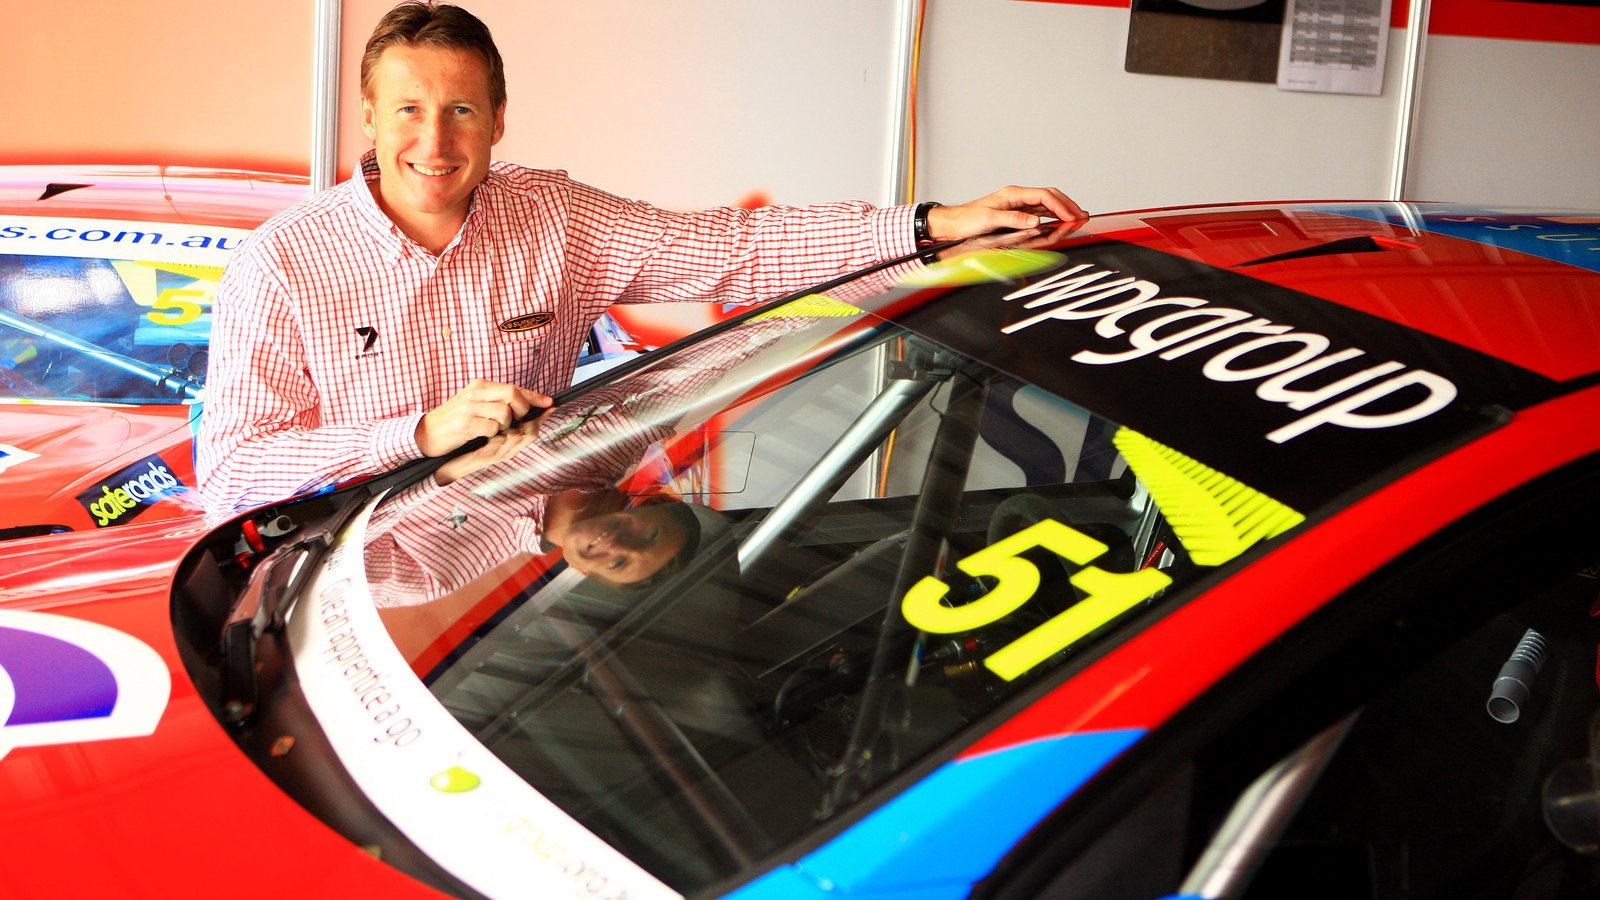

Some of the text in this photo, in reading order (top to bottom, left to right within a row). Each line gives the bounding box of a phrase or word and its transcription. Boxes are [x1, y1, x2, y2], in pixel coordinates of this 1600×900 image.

[147, 288, 214, 326] 5
[355, 327, 379, 352] 7
[1001, 264, 1457, 444] wpcgroup
[90, 462, 178, 527] saferoads
[901, 518, 1174, 682] 51
[322, 609, 351, 635] an
[321, 628, 393, 712] apprentice
[373, 704, 401, 724] a
[373, 717, 422, 748] go
